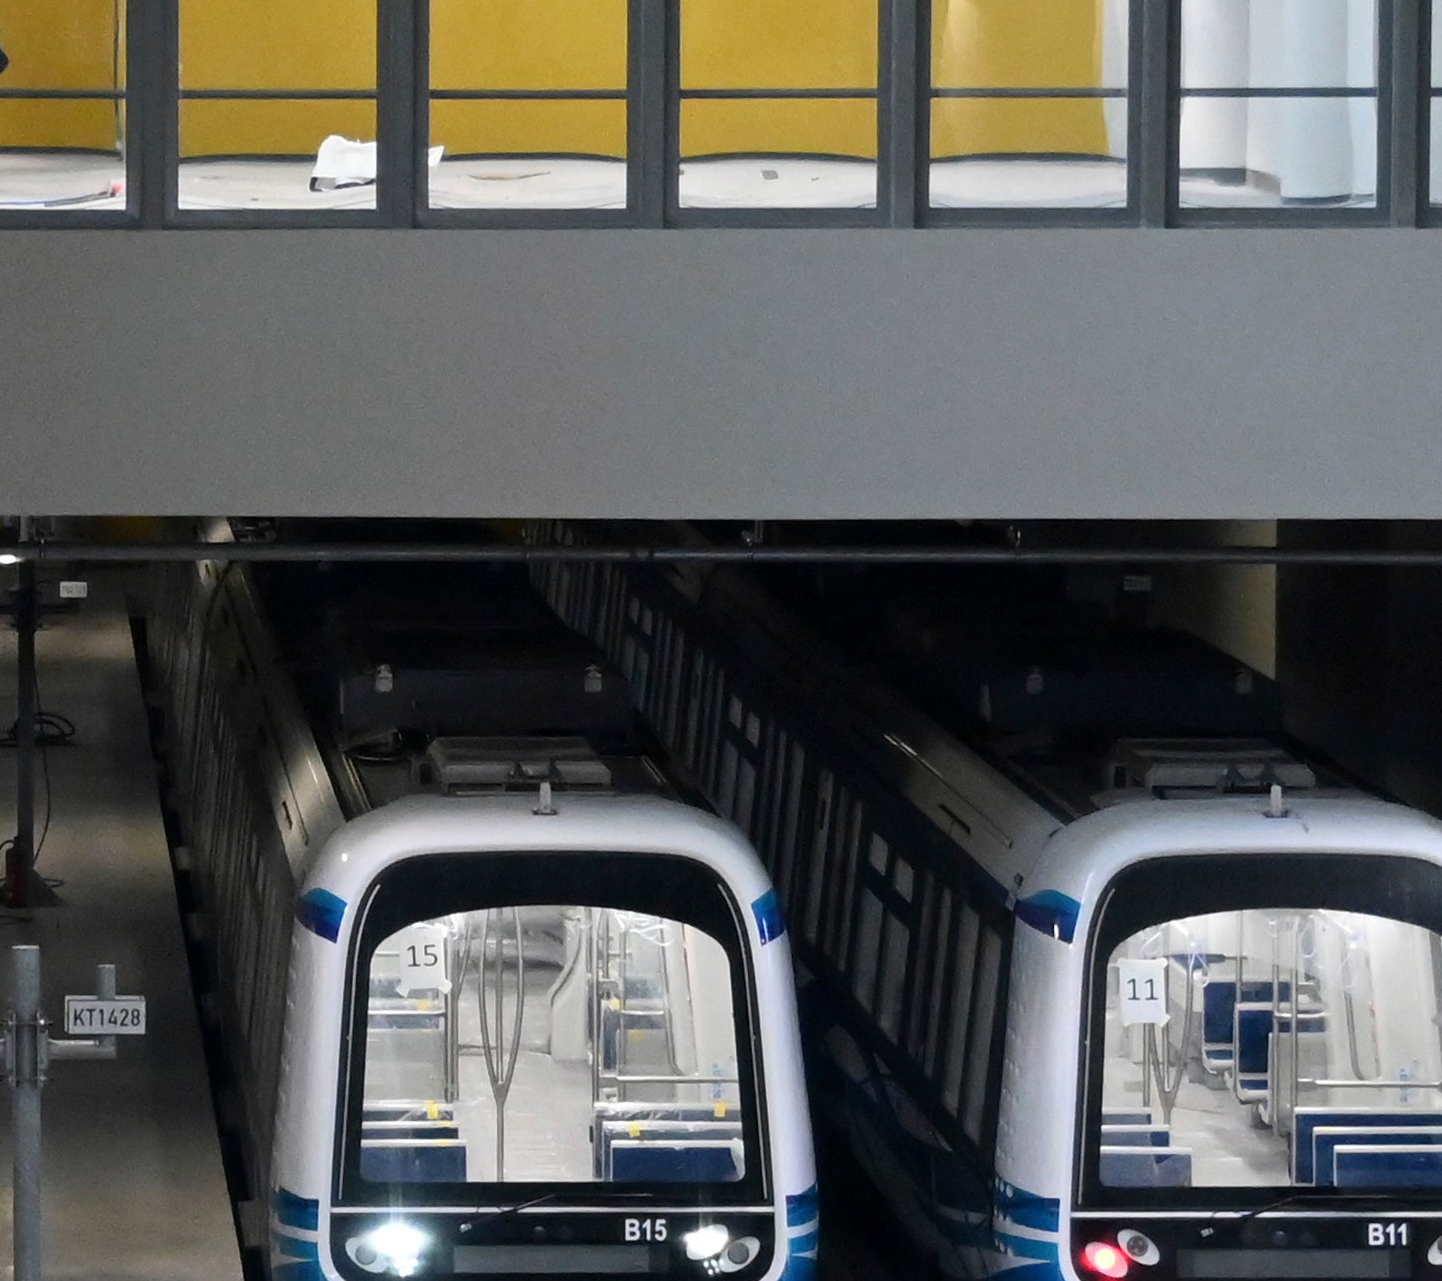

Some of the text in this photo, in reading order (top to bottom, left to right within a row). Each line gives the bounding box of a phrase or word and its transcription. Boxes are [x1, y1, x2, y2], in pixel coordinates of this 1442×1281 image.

[407, 943, 439, 968] 15
[1127, 977, 1159, 1001] 11
[73, 1008, 141, 1027] KT1428
[624, 1218, 667, 1242] B15
[1368, 1222, 1407, 1246] B11
